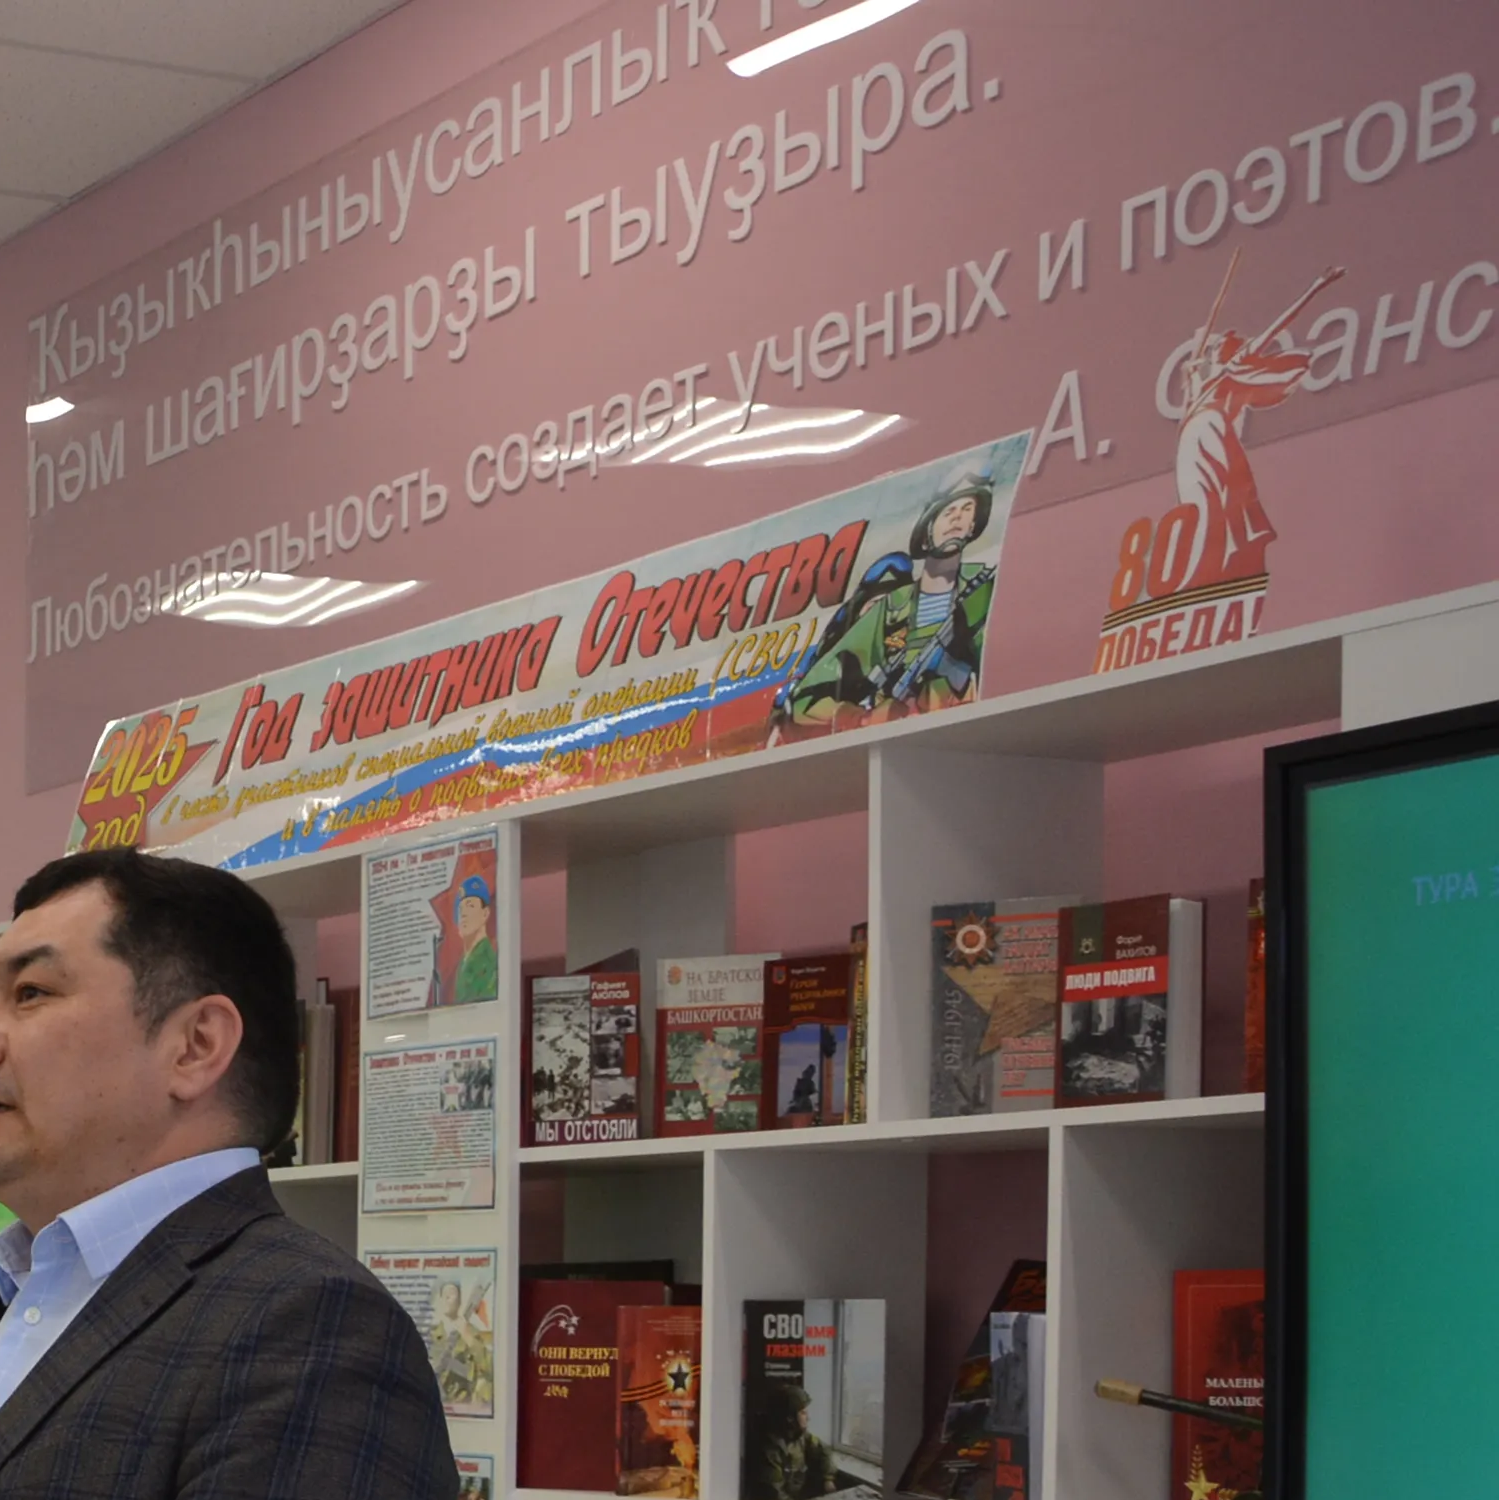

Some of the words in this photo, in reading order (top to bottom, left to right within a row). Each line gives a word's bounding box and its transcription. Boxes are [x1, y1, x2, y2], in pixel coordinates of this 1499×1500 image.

[564, 28, 1002, 280] тыуҙыра.
[27, 463, 449, 664] Любознательность
[464, 362, 709, 489] создает
[729, 249, 1012, 434] ученых
[1038, 217, 1087, 302] и
[1026, 370, 1114, 476] А.
[1108, 502, 1201, 614] 80
[211, 684, 305, 788] Год
[309, 614, 563, 754] защитника
[575, 519, 870, 679] Отечества
[1092, 596, 1266, 675] ПОБЕДА!
[486, 689, 581, 748] военной
[581, 667, 700, 720] операции
[708, 616, 819, 698] (СВО)
[84, 704, 200, 806] 2025
[321, 785, 404, 833] память
[409, 793, 421, 813] о
[537, 744, 587, 783] всех
[594, 708, 700, 781] предков
[85, 795, 147, 852] год
[685, 970, 704, 987] НА
[707, 966, 764, 985] БРАТСКО
[1065, 972, 1102, 991] ЛЮДИ
[1103, 965, 1157, 988] ПОДВИГА
[535, 1120, 558, 1143] МЫ
[564, 1118, 639, 1142] ОТСТОЯЛИ
[538, 1364, 547, 1377] С
[549, 1363, 611, 1379] ПОБЕДОЙ
[539, 1346, 567, 1360] ОНИ
[766, 1343, 828, 1358] глазами
